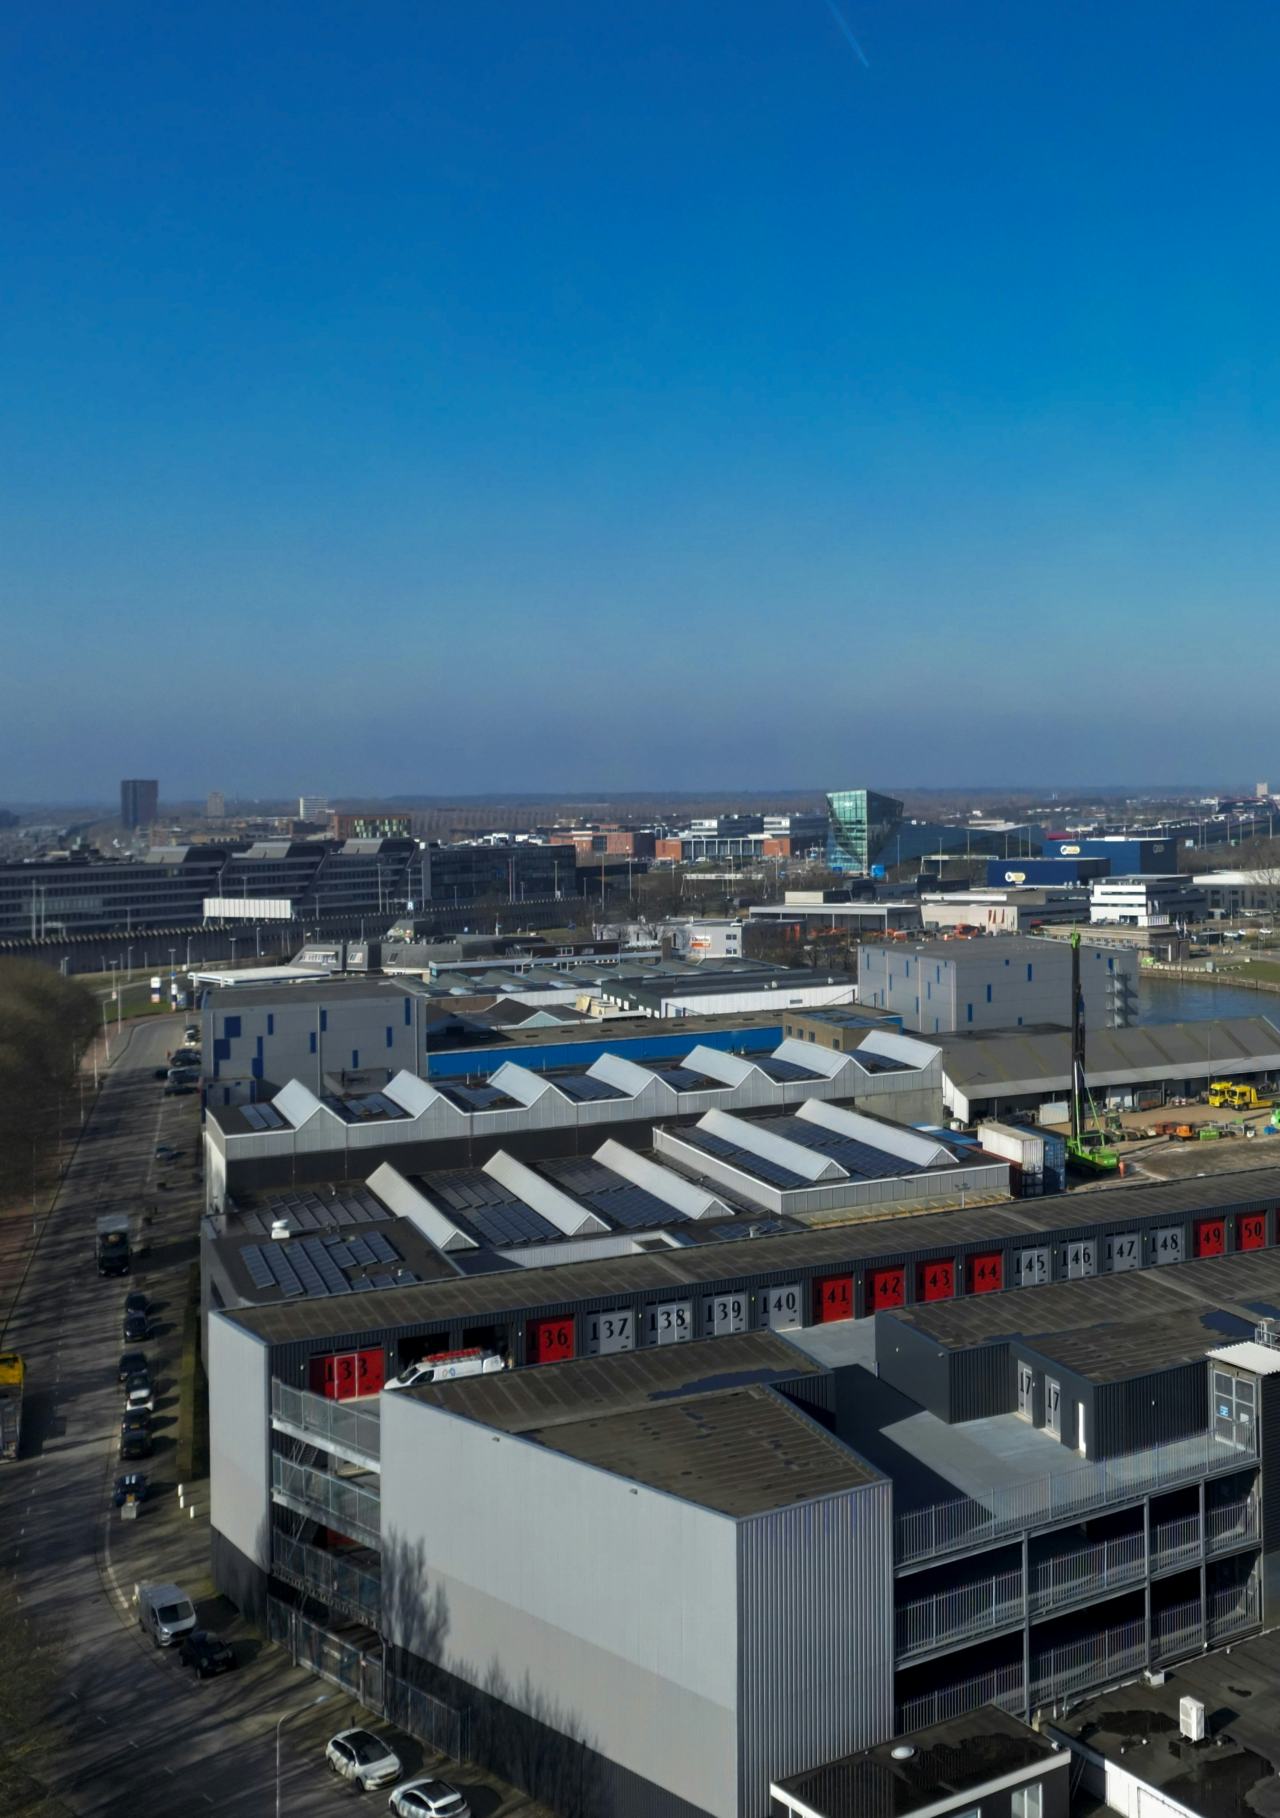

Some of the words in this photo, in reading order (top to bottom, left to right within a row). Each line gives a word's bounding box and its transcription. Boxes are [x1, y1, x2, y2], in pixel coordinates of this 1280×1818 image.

[1106, 1240, 1135, 1259] 147
[1150, 1234, 1178, 1253] 148
[1014, 1254, 1045, 1274] 145
[1061, 1247, 1091, 1266] 146
[705, 1300, 741, 1323] 139
[761, 1292, 796, 1314] 140
[590, 1317, 628, 1341] 137
[648, 1308, 686, 1332] 138
[326, 1357, 368, 1381] 133
